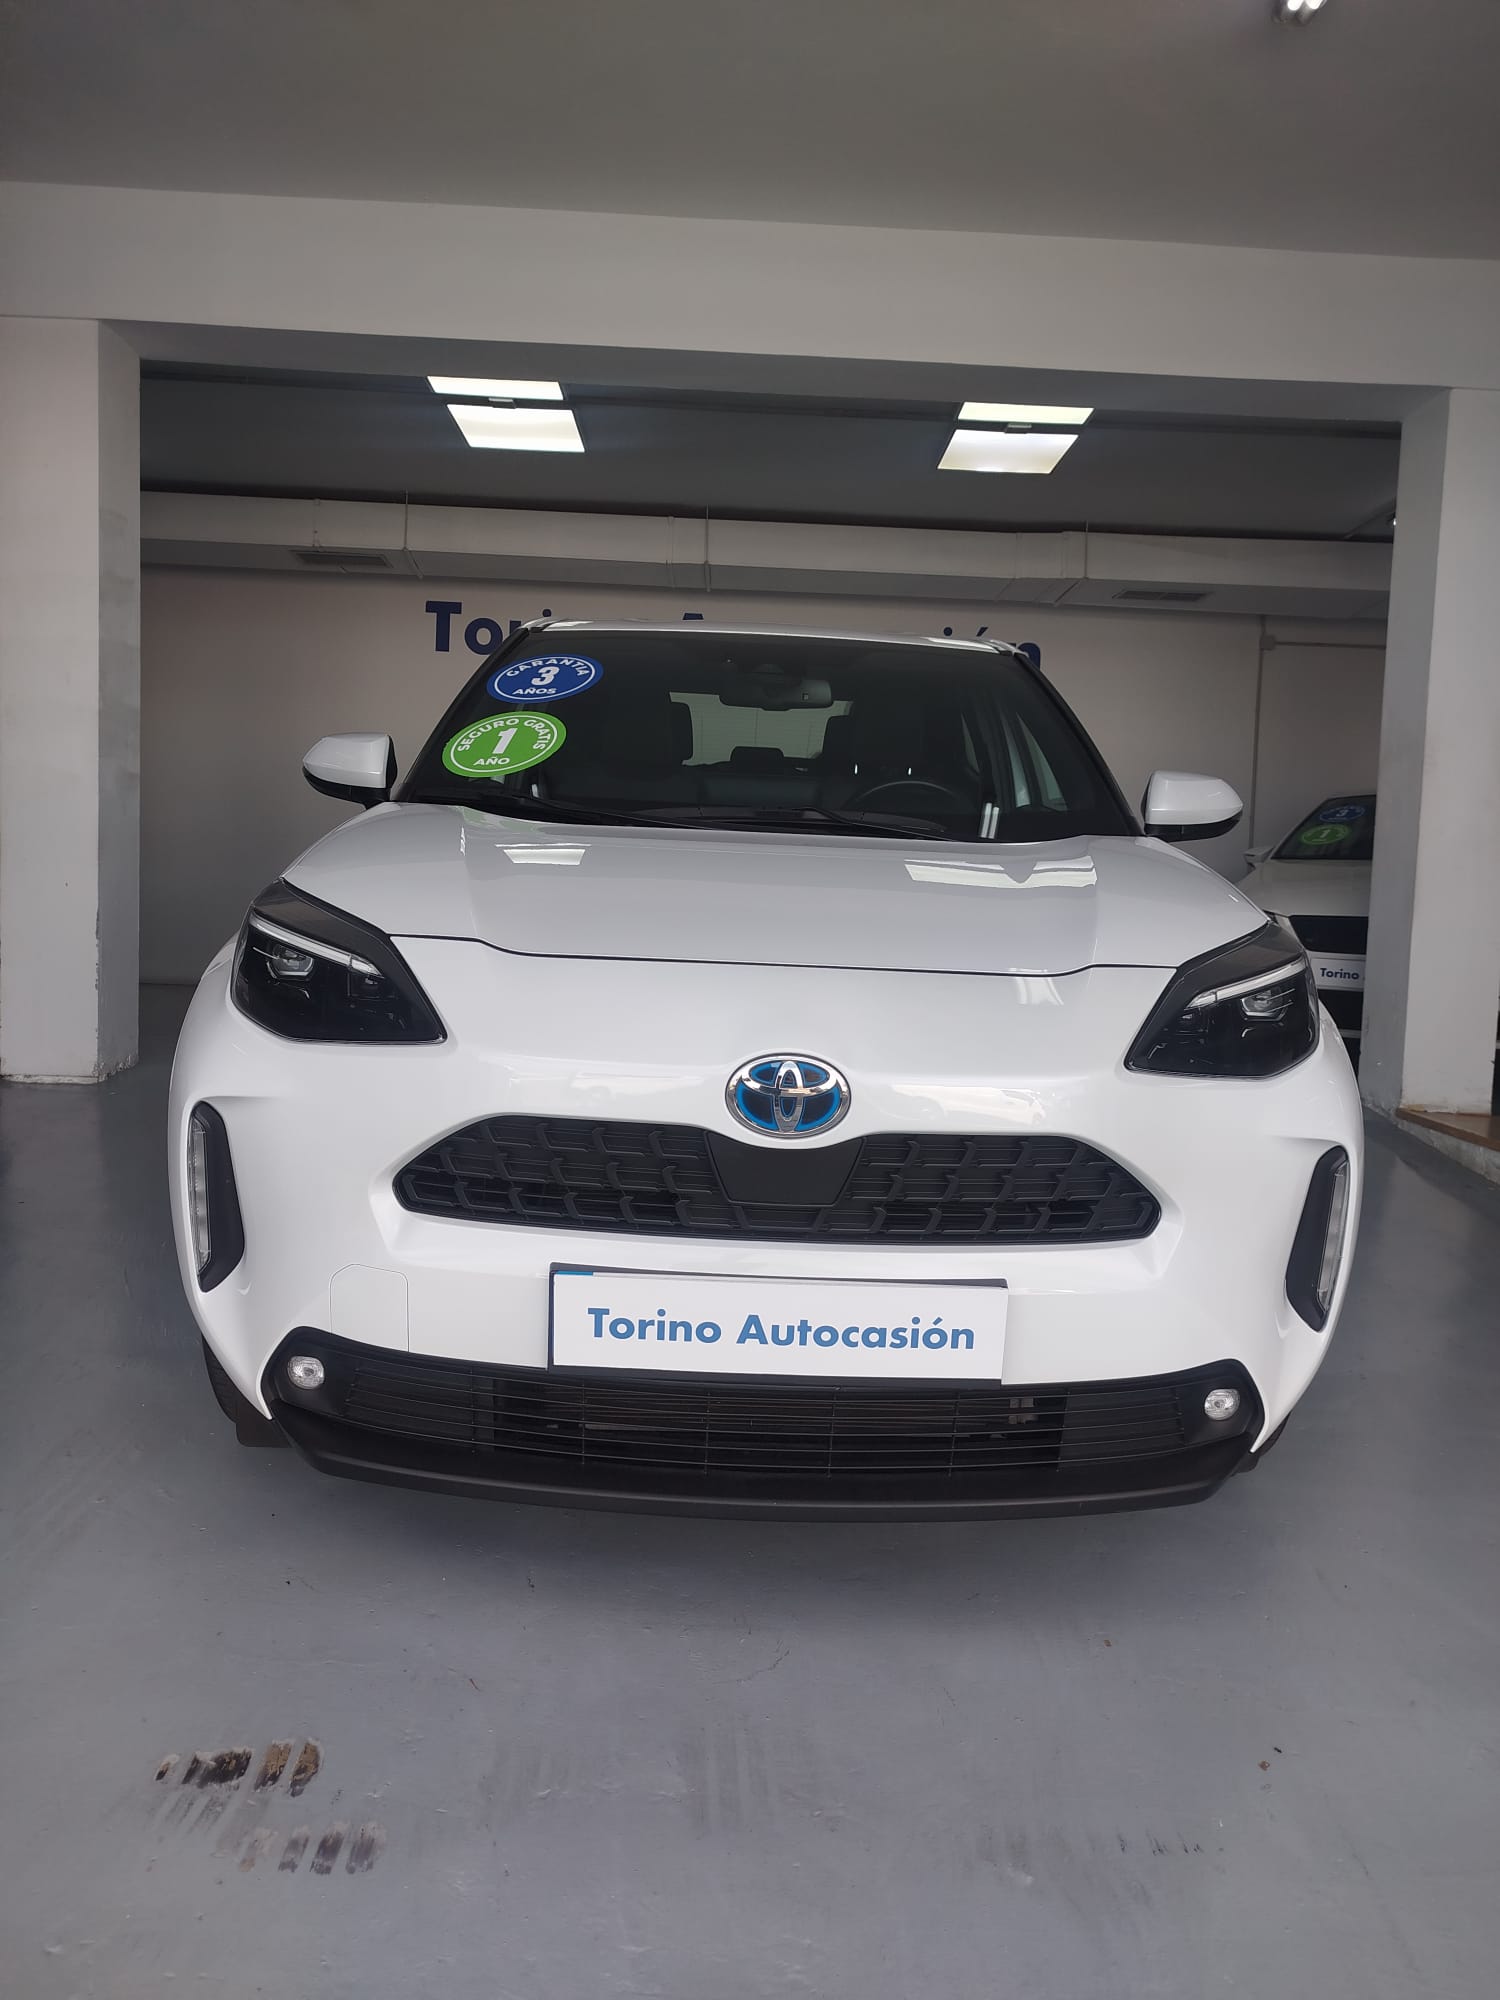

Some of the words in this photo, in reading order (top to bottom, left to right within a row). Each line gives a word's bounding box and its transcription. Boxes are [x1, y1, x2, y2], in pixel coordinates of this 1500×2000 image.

[531, 666, 560, 686] 3
[512, 687, 557, 695] AÑOS
[457, 718, 520, 752] SEGURO
[523, 719, 551, 750] GRATIS
[492, 728, 518, 754] 1
[473, 756, 510, 766] AÑO
[1319, 967, 1360, 980] Torino
[587, 1307, 722, 1344] Torino
[735, 1314, 976, 1350] Autocasión
